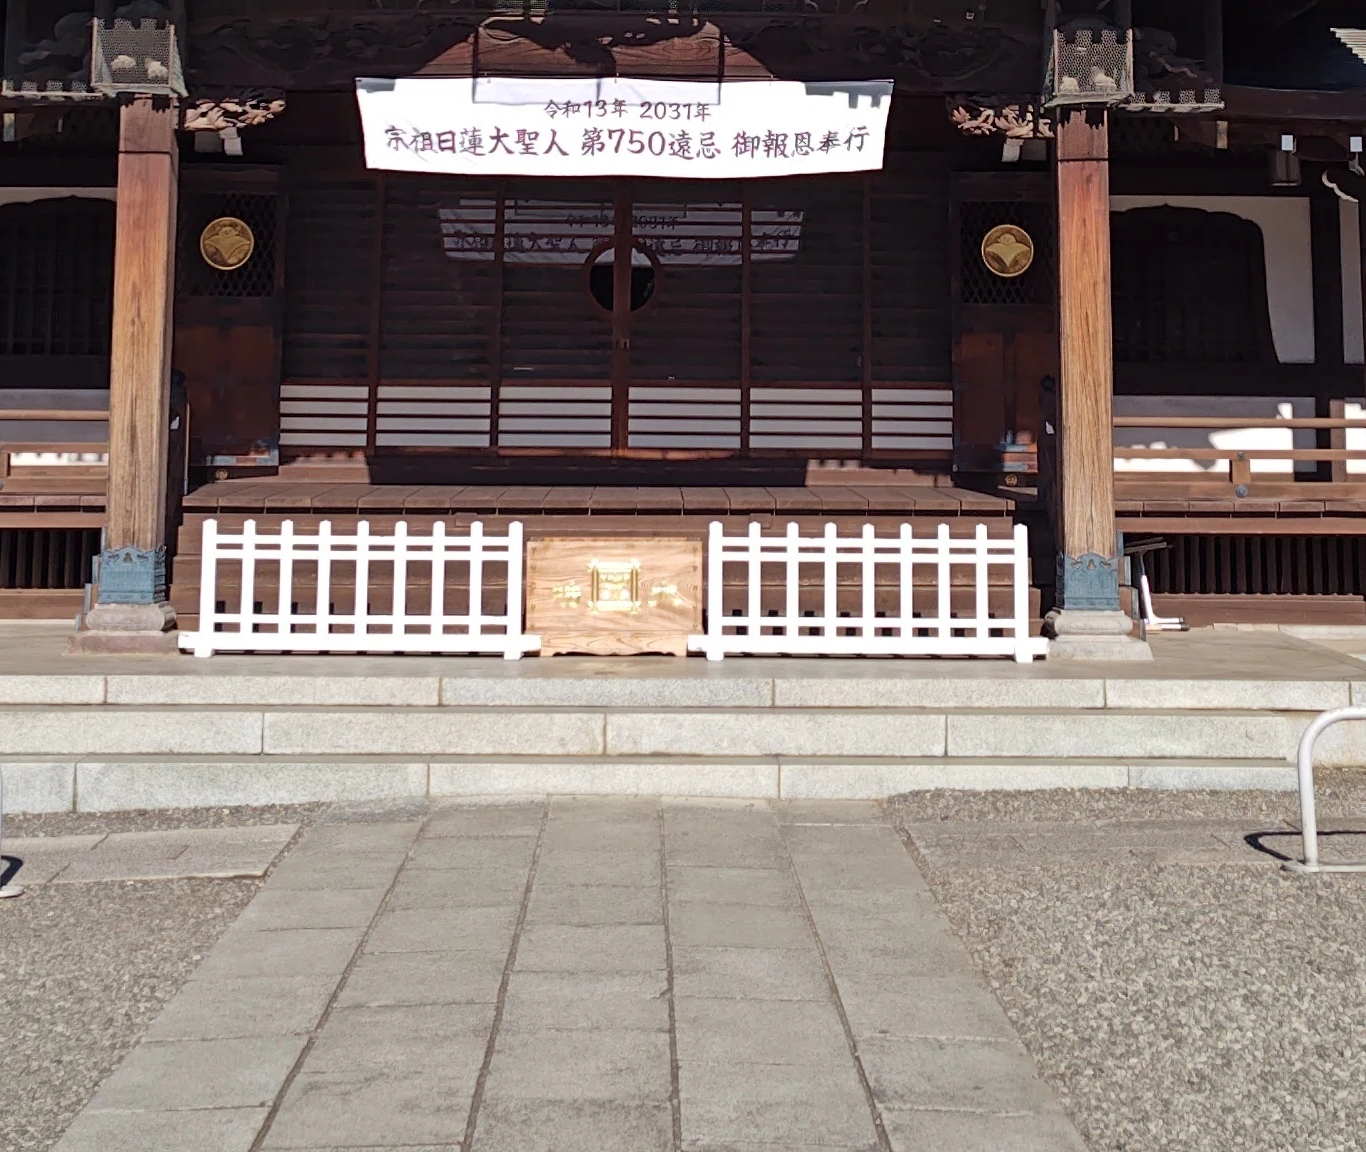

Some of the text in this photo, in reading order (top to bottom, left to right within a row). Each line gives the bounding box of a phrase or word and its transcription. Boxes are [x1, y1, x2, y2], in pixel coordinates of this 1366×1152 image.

[544, 99, 712, 122] 令和13年 2031年
[384, 125, 871, 161] 宗祖日蓮大聖人 第750遠忌 御報恩奉行
